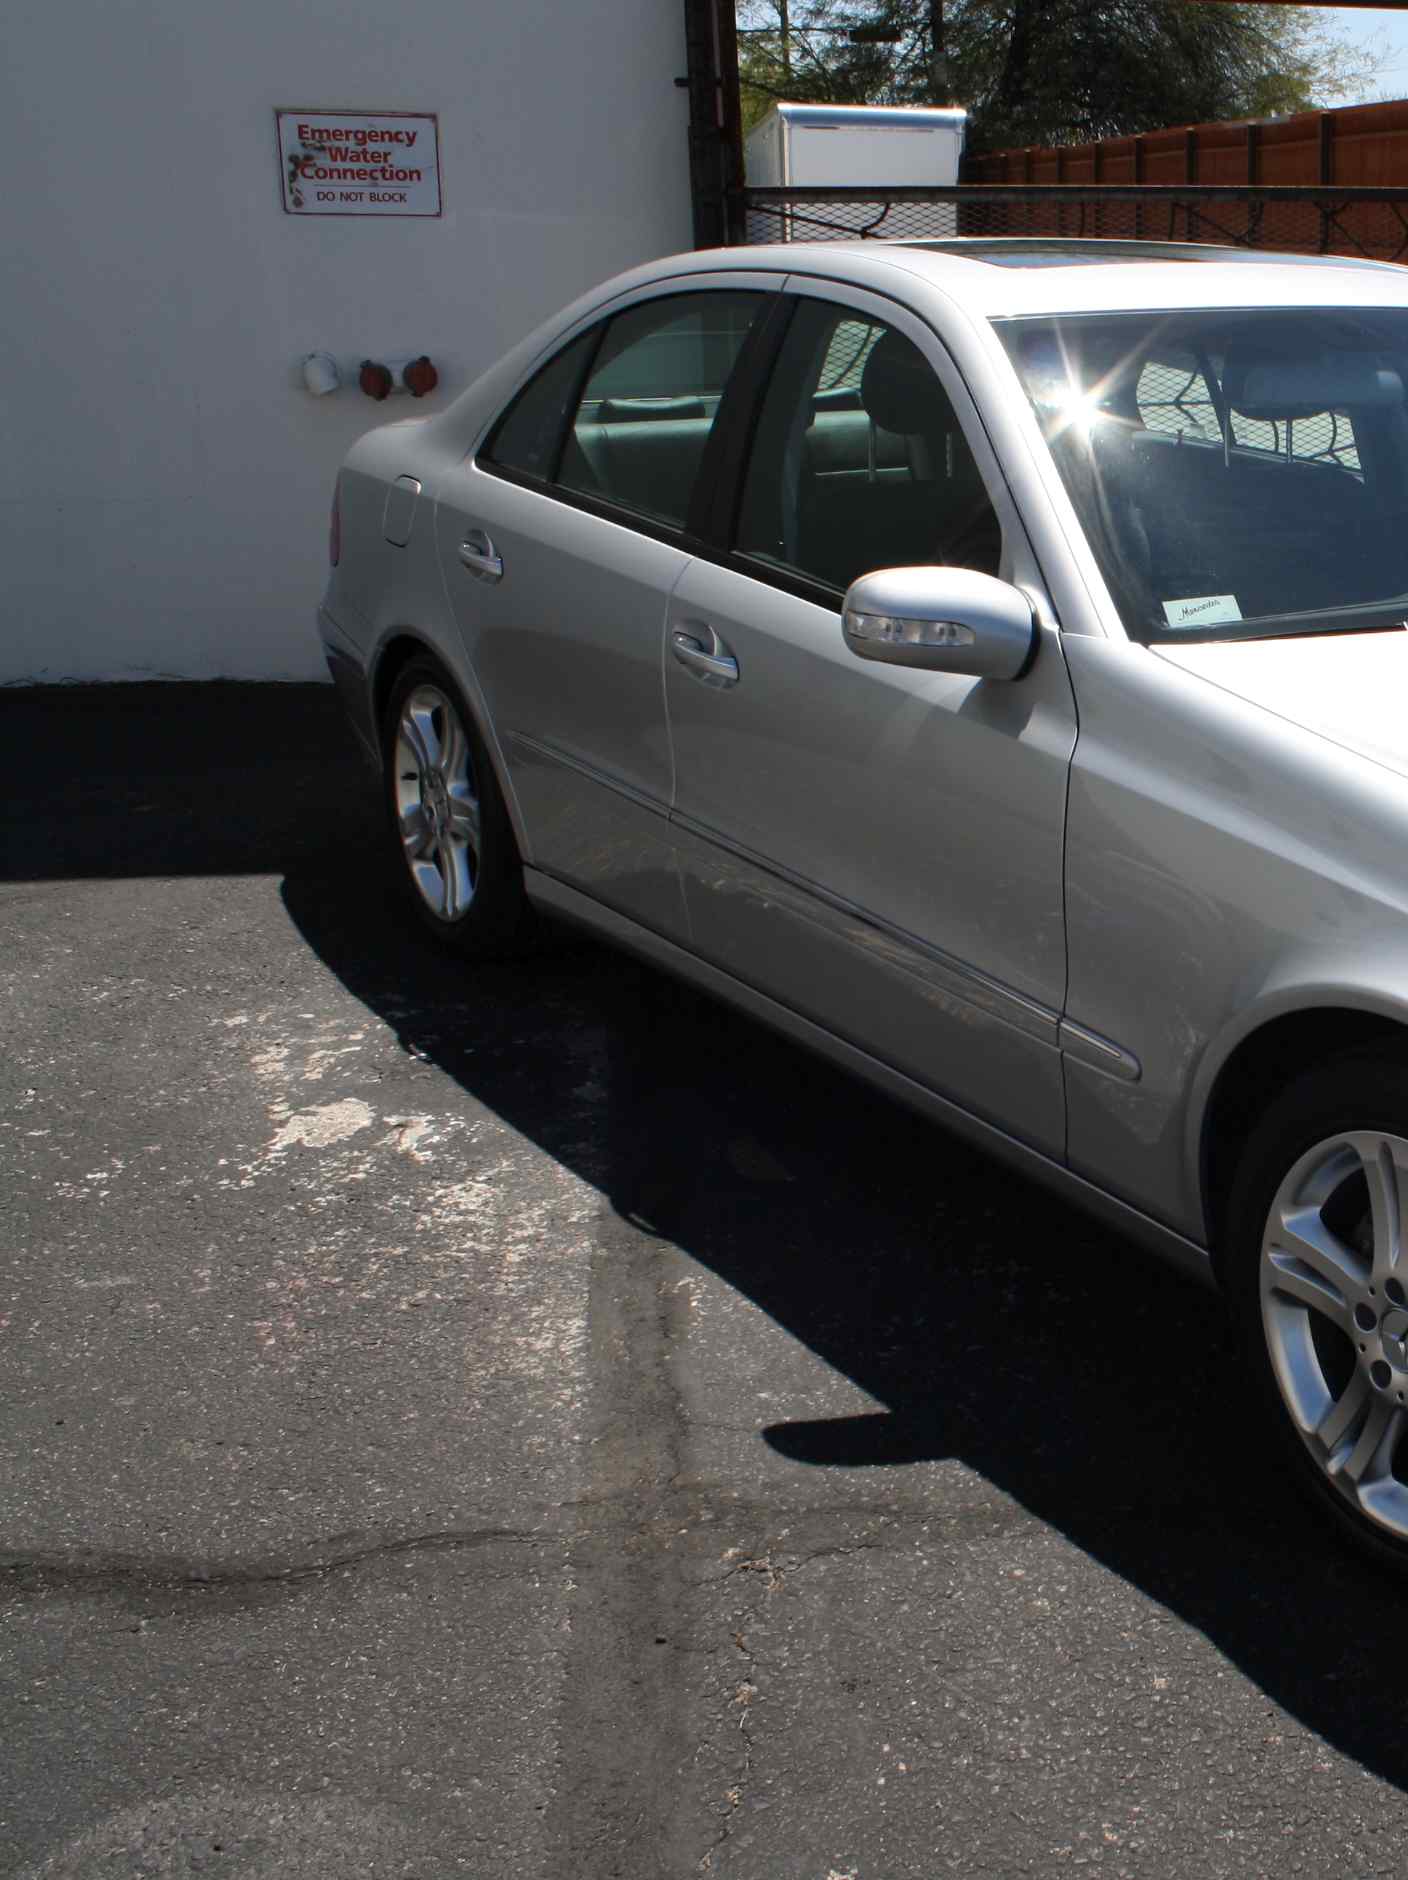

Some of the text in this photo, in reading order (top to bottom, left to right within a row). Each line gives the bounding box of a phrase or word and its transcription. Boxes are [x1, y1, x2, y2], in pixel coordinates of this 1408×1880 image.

[297, 124, 417, 147] Emergency
[327, 147, 391, 164] Water
[300, 163, 421, 182] Connection
[316, 191, 407, 203] DO NOT BLOCK
